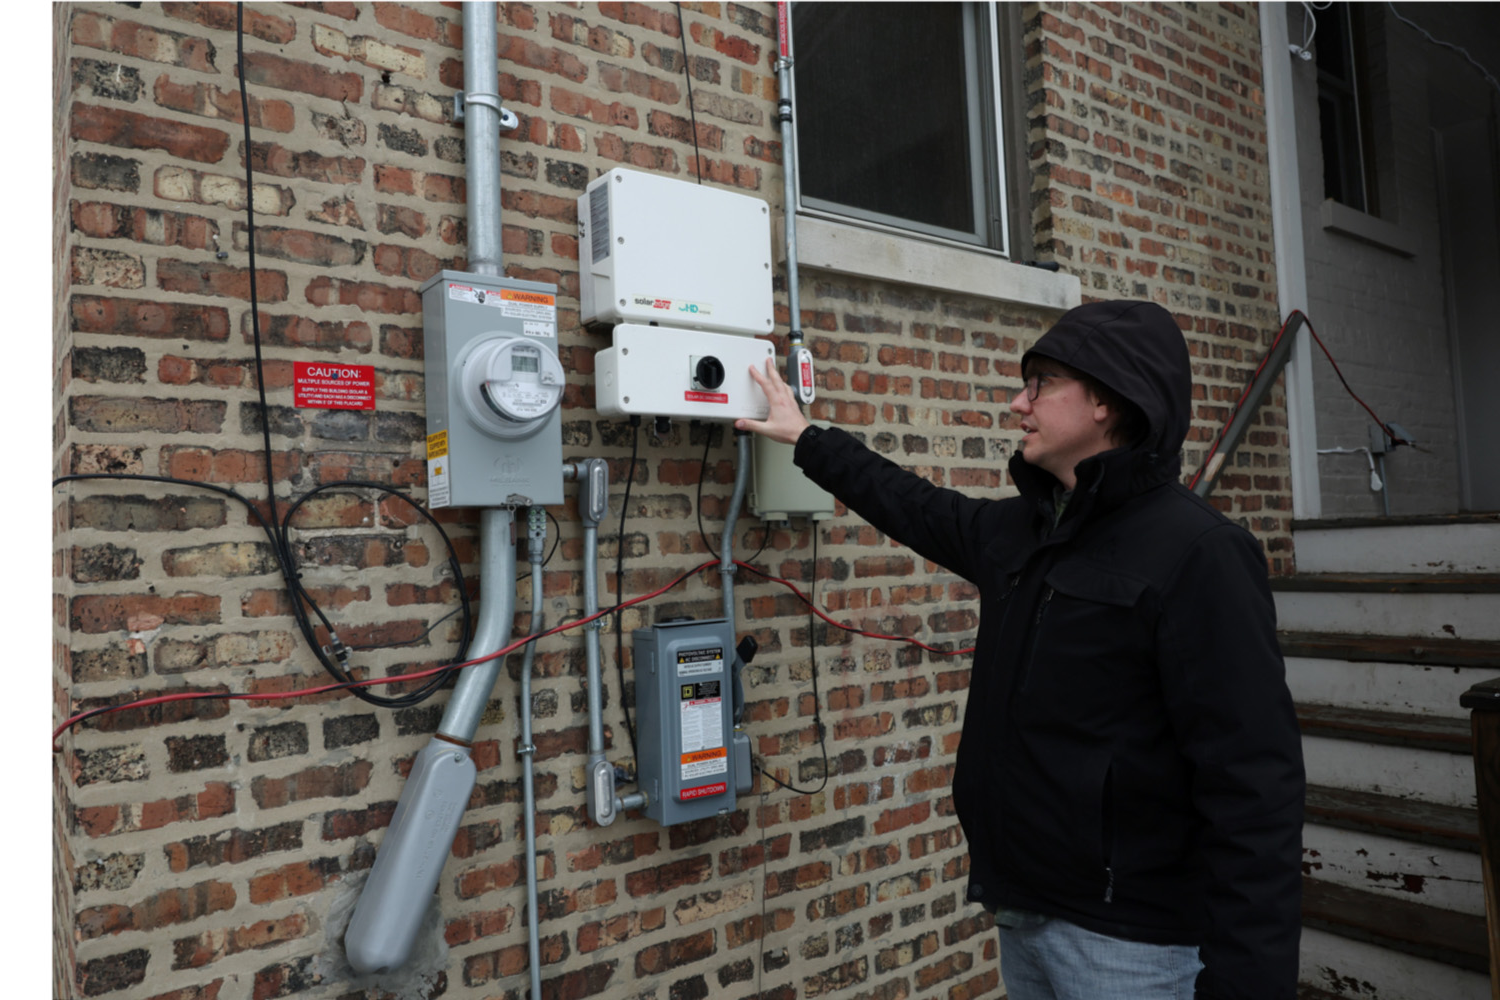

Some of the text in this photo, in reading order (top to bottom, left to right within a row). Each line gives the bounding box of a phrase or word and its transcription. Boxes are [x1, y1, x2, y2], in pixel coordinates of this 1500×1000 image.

[514, 292, 548, 304] WARNING
[307, 367, 361, 378] CAUTION:
[692, 750, 722, 760] WARNING
[682, 785, 724, 798] RAPID SHUTDOWN
